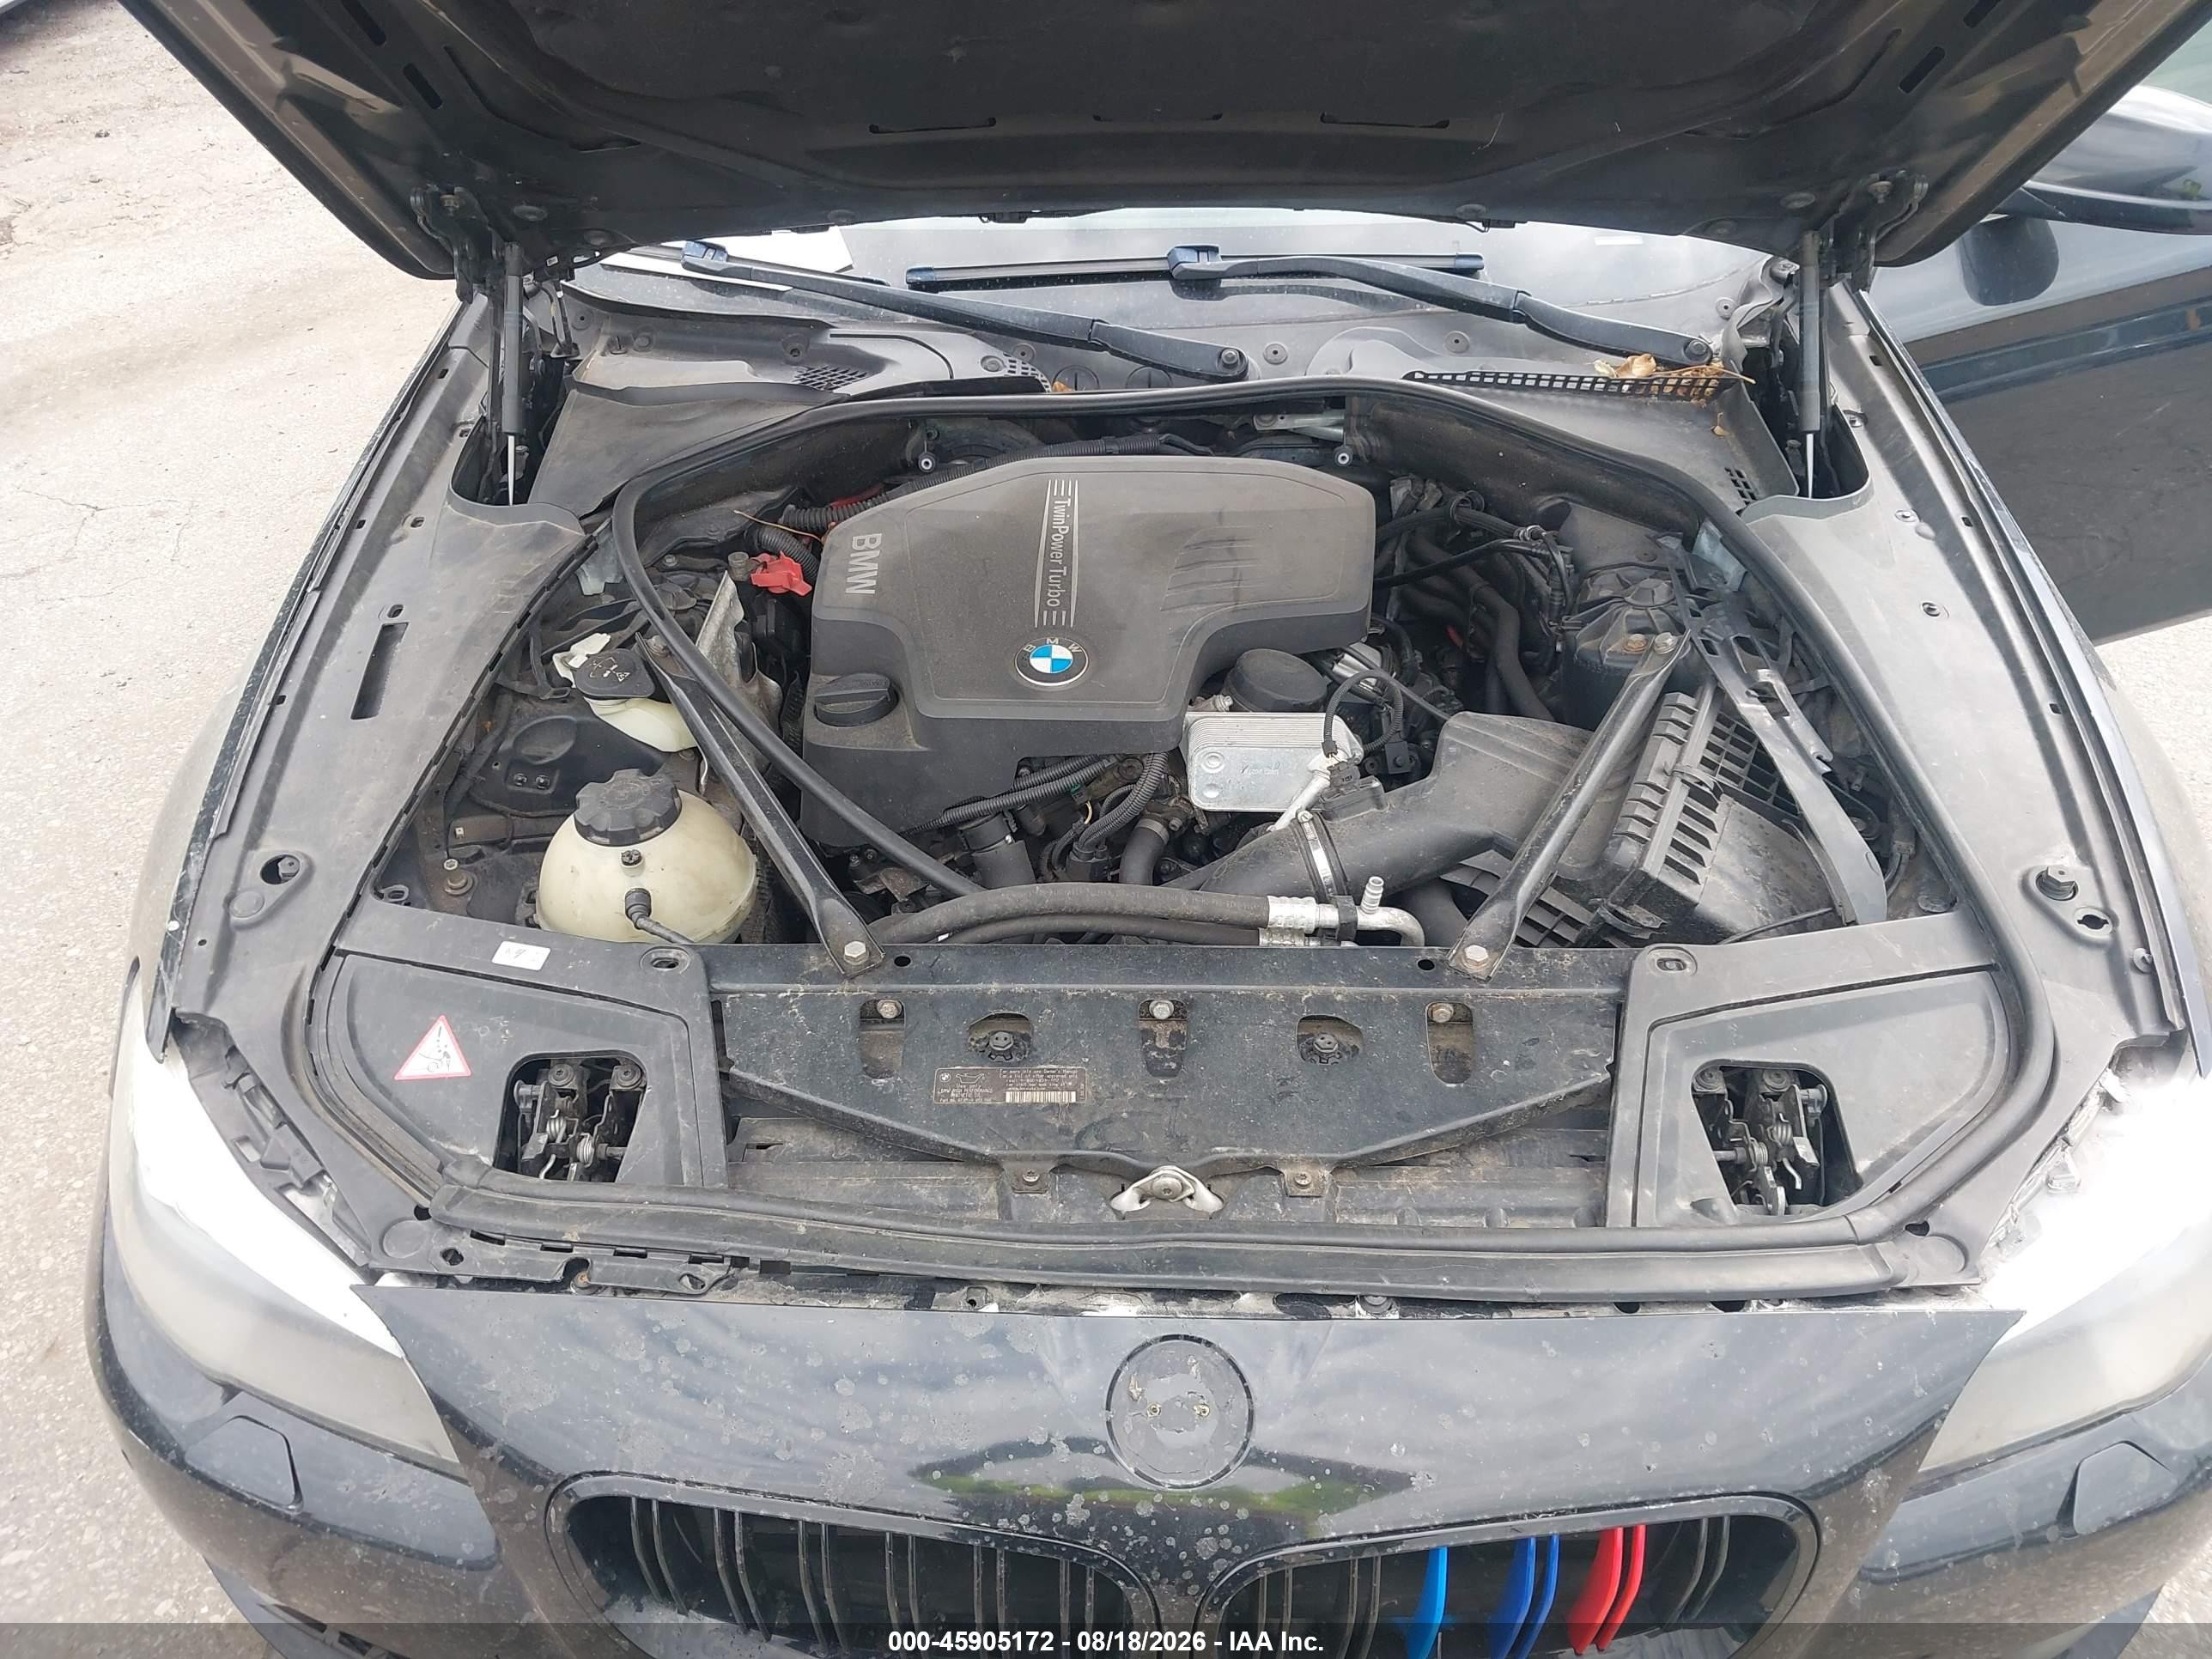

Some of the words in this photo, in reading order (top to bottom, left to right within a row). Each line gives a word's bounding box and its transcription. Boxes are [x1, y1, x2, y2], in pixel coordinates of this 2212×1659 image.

[1049, 498, 1072, 564] TwinPower
[845, 533, 882, 594] BMW
[1047, 566, 1067, 607] Turbo
[1023, 637, 1083, 653] BMW
